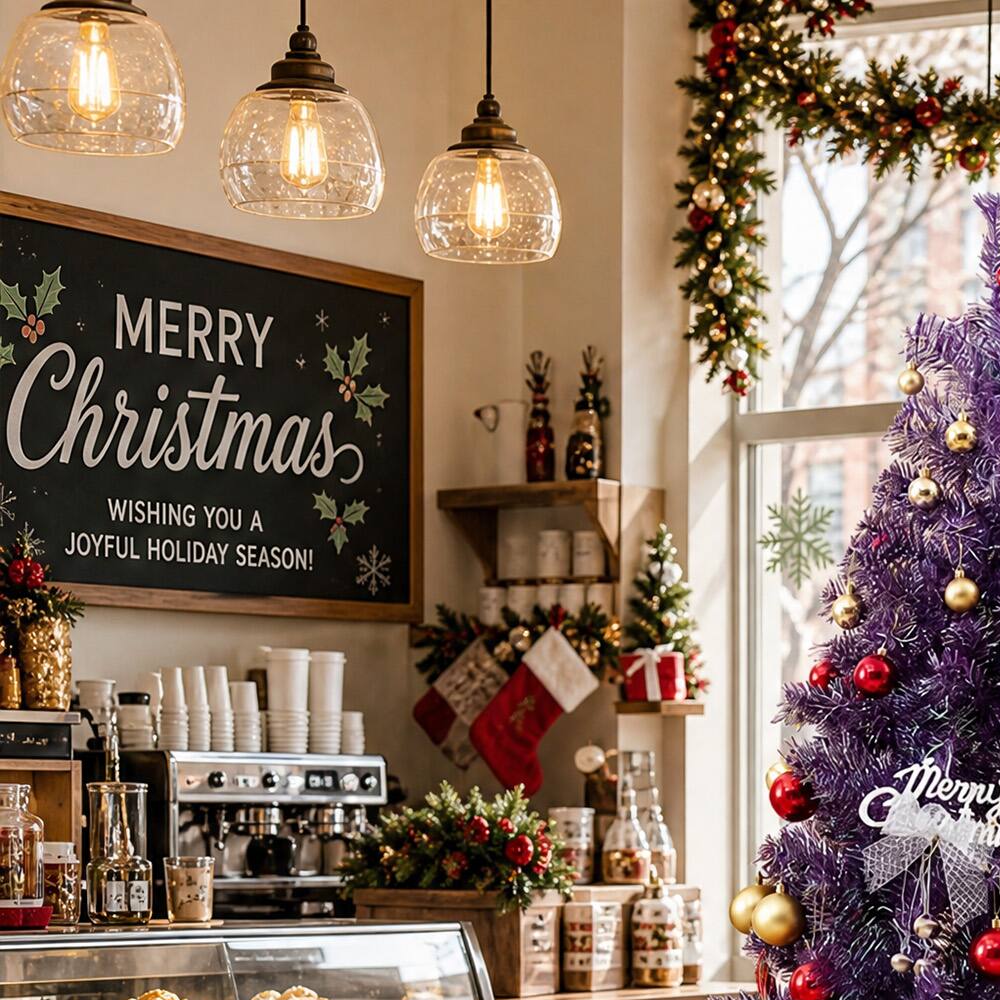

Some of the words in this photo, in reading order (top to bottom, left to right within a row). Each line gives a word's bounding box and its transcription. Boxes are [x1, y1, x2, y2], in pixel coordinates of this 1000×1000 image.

[115, 293, 274, 368] MERRY
[6, 341, 364, 485] Christmas
[107, 498, 196, 527] WISHING
[203, 505, 242, 531] YOU
[249, 510, 264, 532] A
[64, 532, 140, 560] JOYFUL
[147, 538, 229, 567] HOLIDAY
[236, 544, 314, 571] SEASON!
